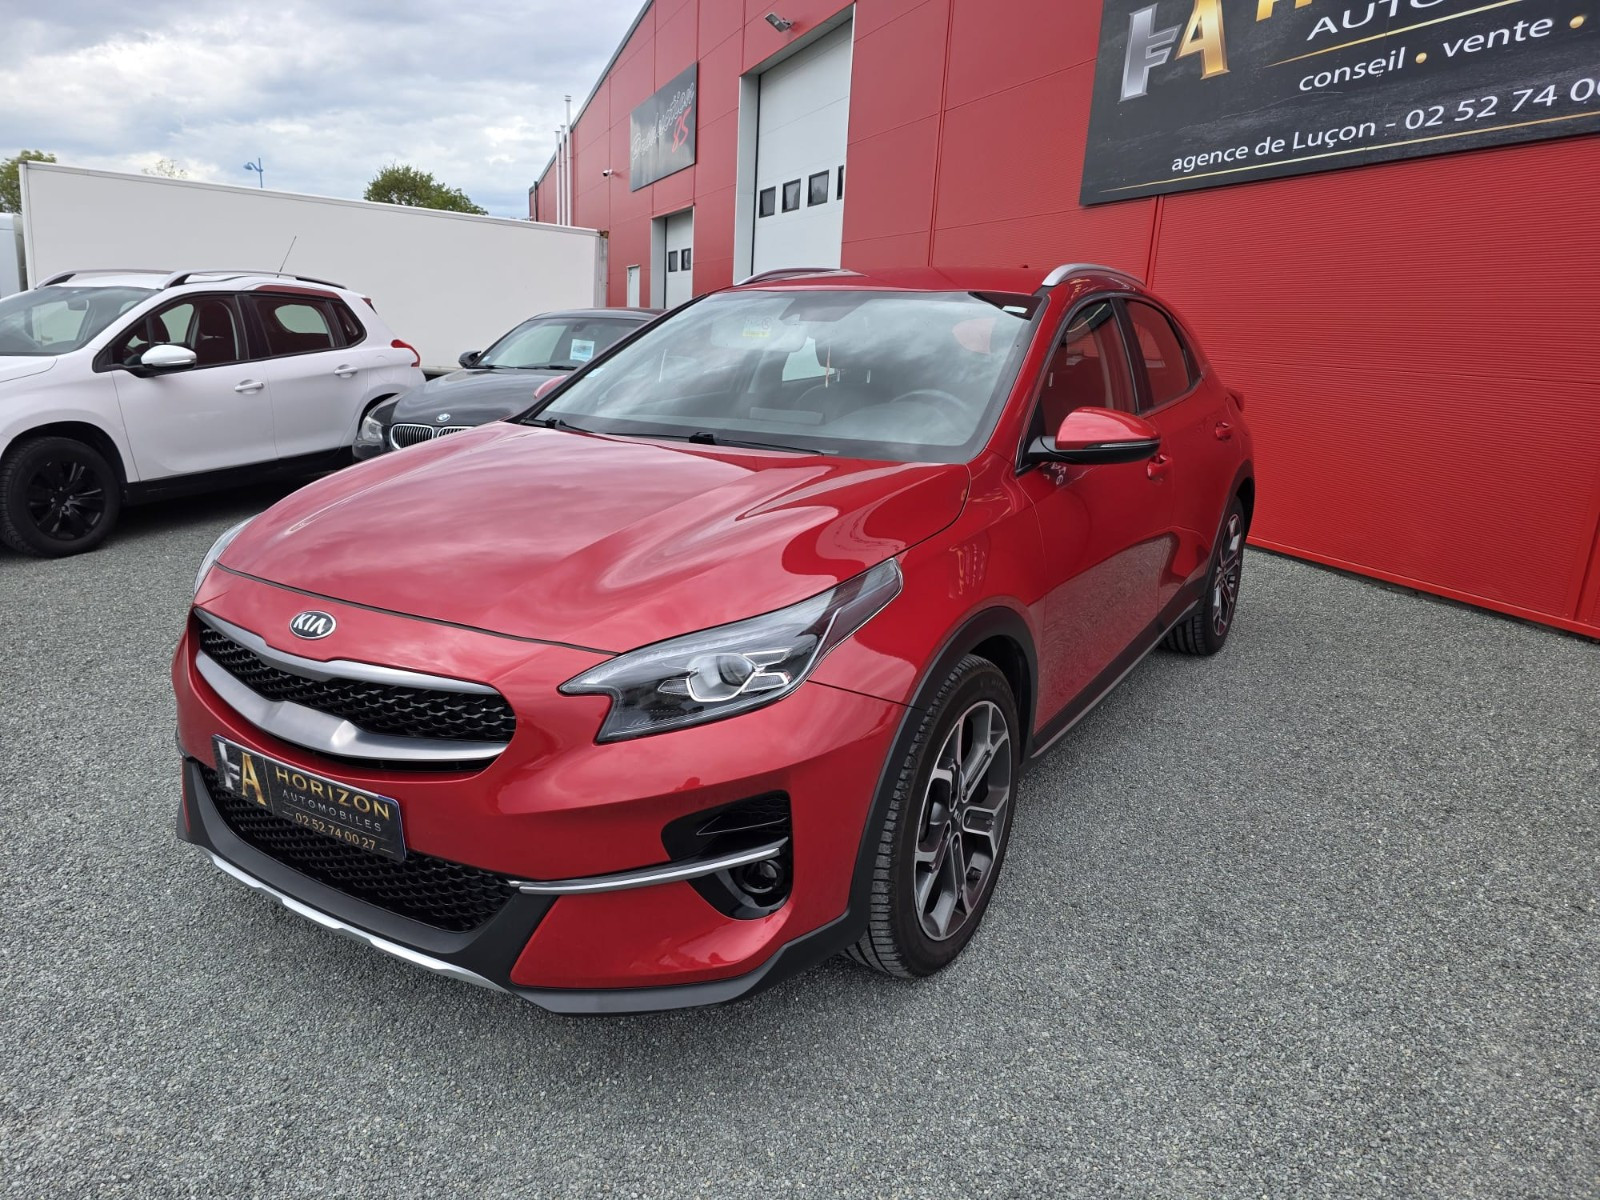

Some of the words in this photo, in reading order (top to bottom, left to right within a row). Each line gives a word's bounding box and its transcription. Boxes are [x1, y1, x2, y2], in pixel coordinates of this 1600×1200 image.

[1299, 47, 1406, 91] conseil
[1443, 18, 1554, 58] vente
[1171, 146, 1249, 173] agence
[1254, 136, 1286, 156] de
[1292, 122, 1376, 148] Luçon
[1405, 105, 1445, 130] 02
[1454, 95, 1499, 122] 52
[1511, 84, 1558, 113] 74
[1569, 77, 1600, 102] 0
[293, 612, 328, 635] KIA
[275, 766, 390, 820] HORIZON
[282, 789, 382, 832] AUTOMOBILES
[295, 813, 310, 826] 02
[312, 818, 326, 833] 52
[328, 825, 342, 838] 74
[344, 831, 360, 844] 00
[361, 837, 376, 850] 27
